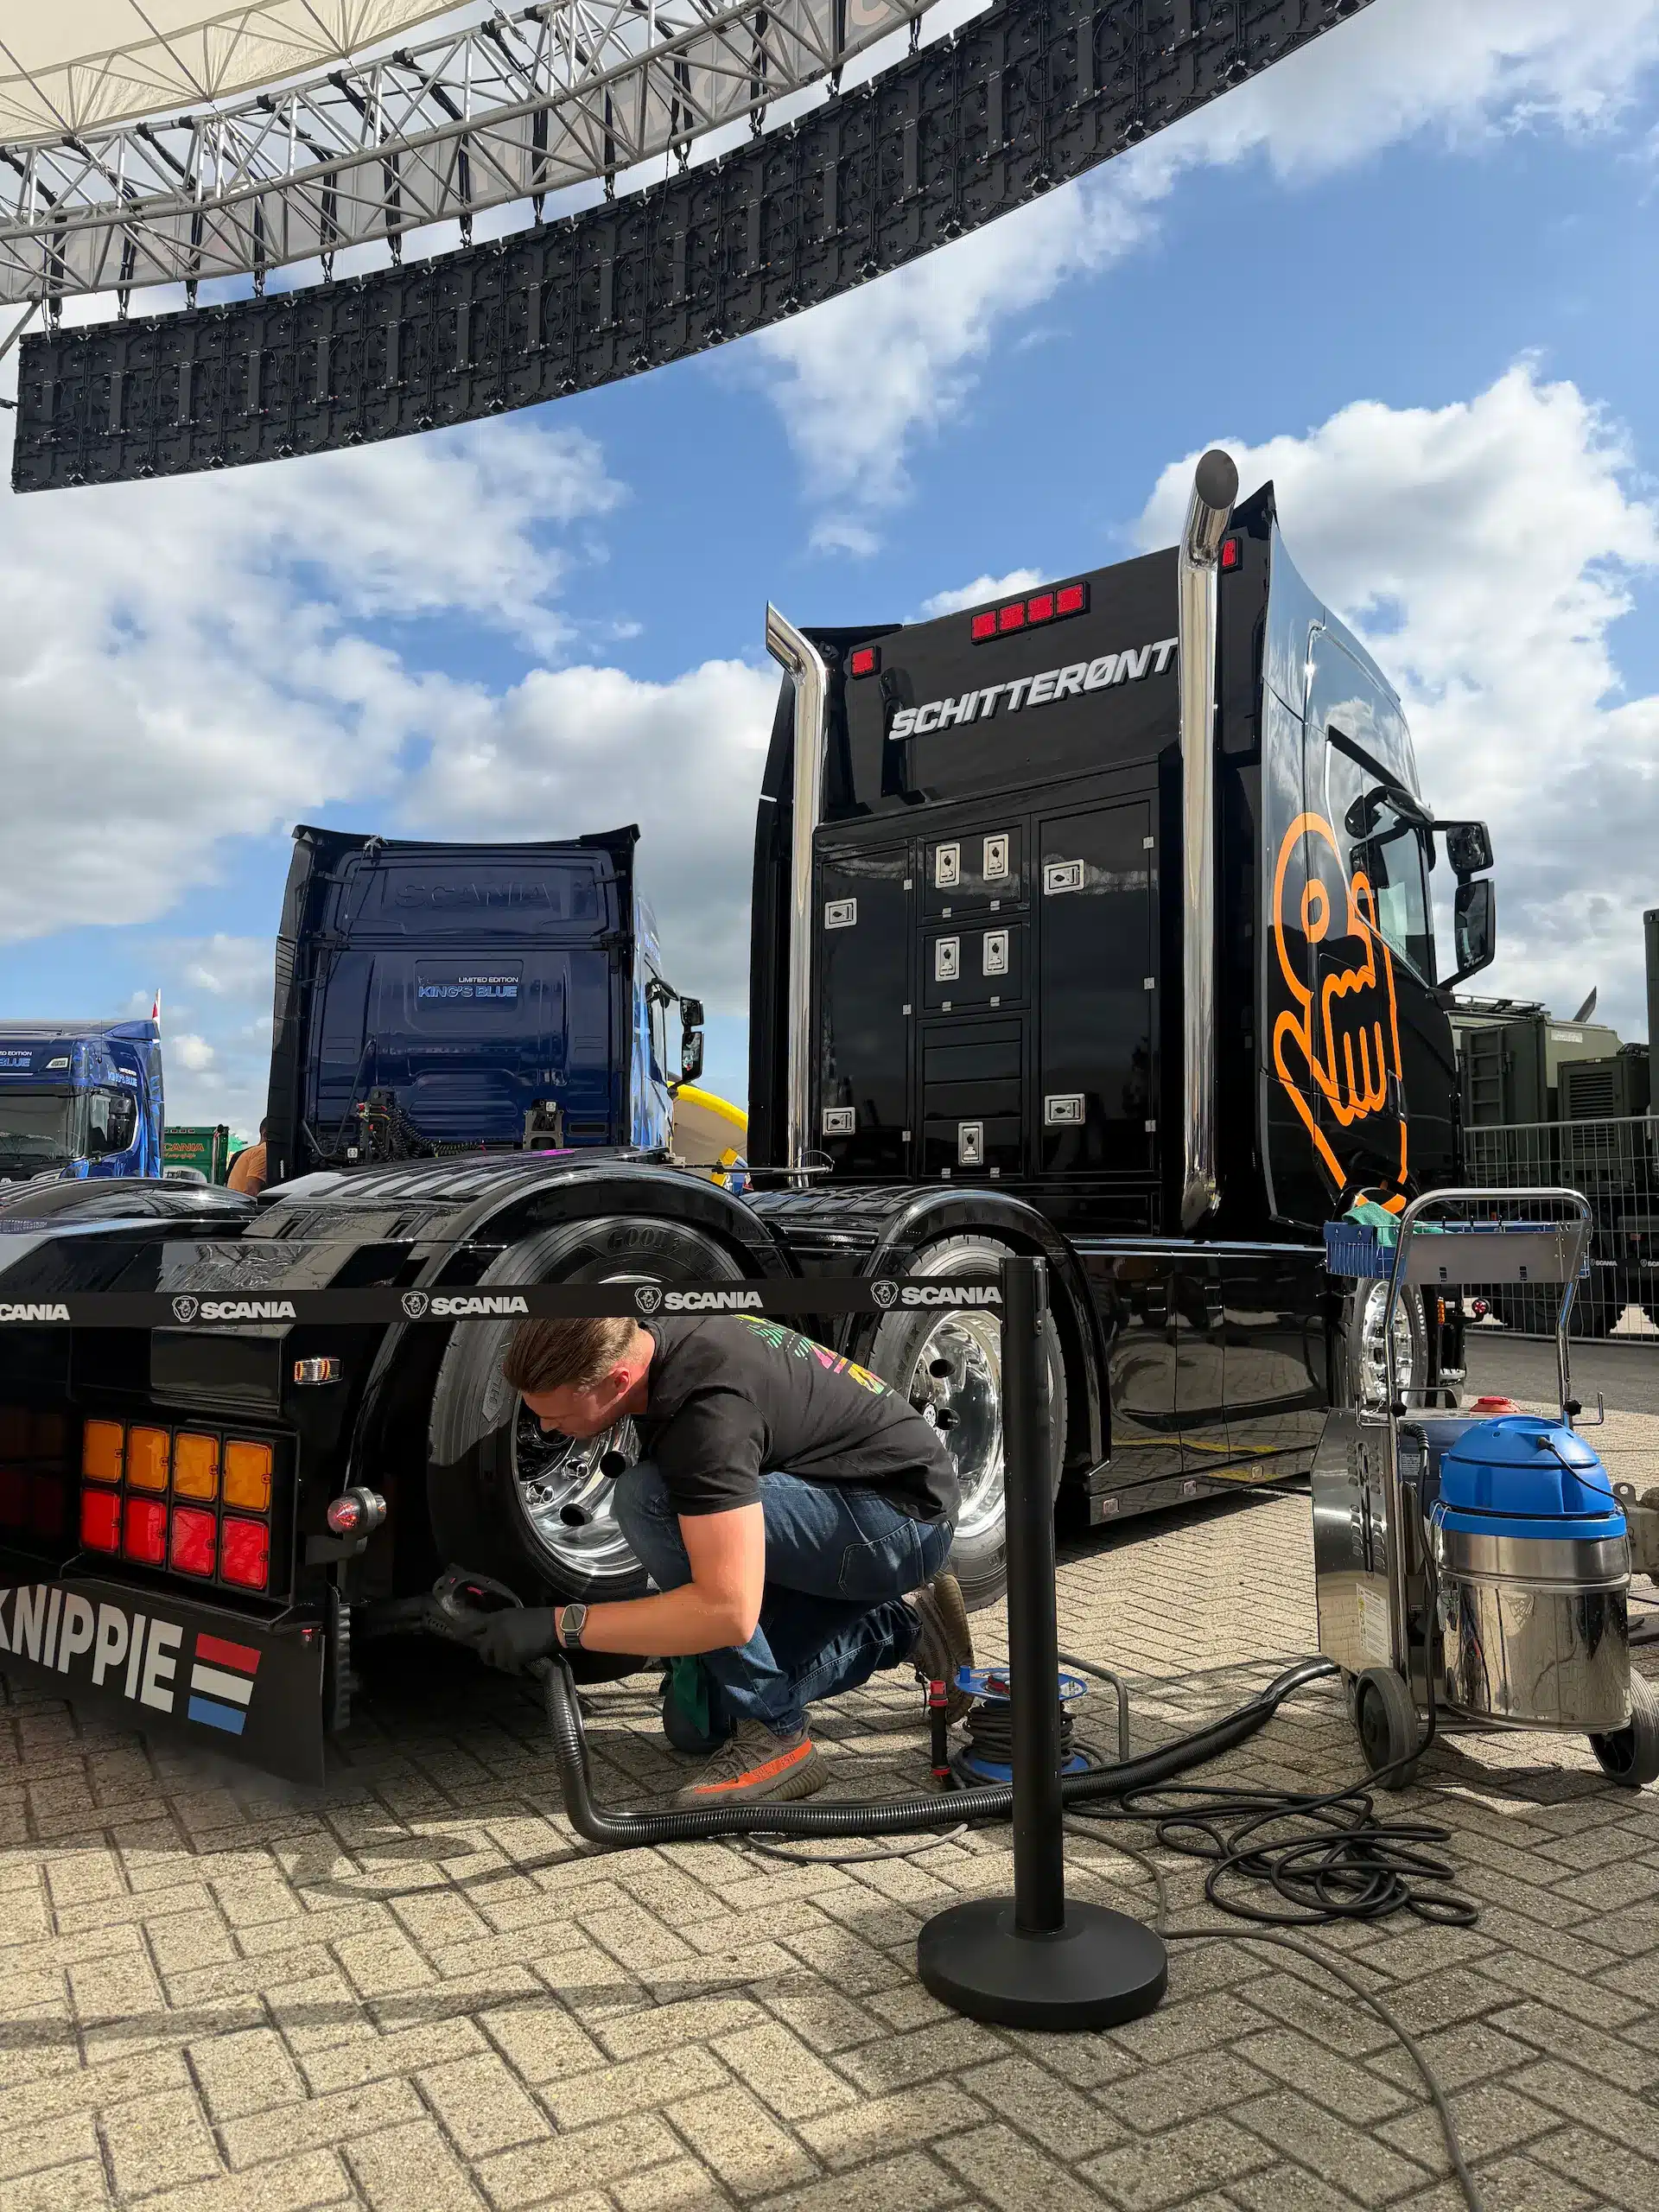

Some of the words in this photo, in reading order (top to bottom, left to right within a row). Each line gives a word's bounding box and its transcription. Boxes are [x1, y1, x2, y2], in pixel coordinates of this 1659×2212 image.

[395, 882, 555, 910] SCANIA
[418, 985, 474, 998] KING'S
[474, 985, 518, 998] BLUE
[163, 1142, 205, 1152] CANIA
[664, 1291, 763, 1310] SCANIA
[901, 1286, 1002, 1306] SCANIA
[0, 1303, 71, 1322] CANIA
[200, 1300, 297, 1320] SCANIA
[431, 1296, 529, 1316] SCANIA
